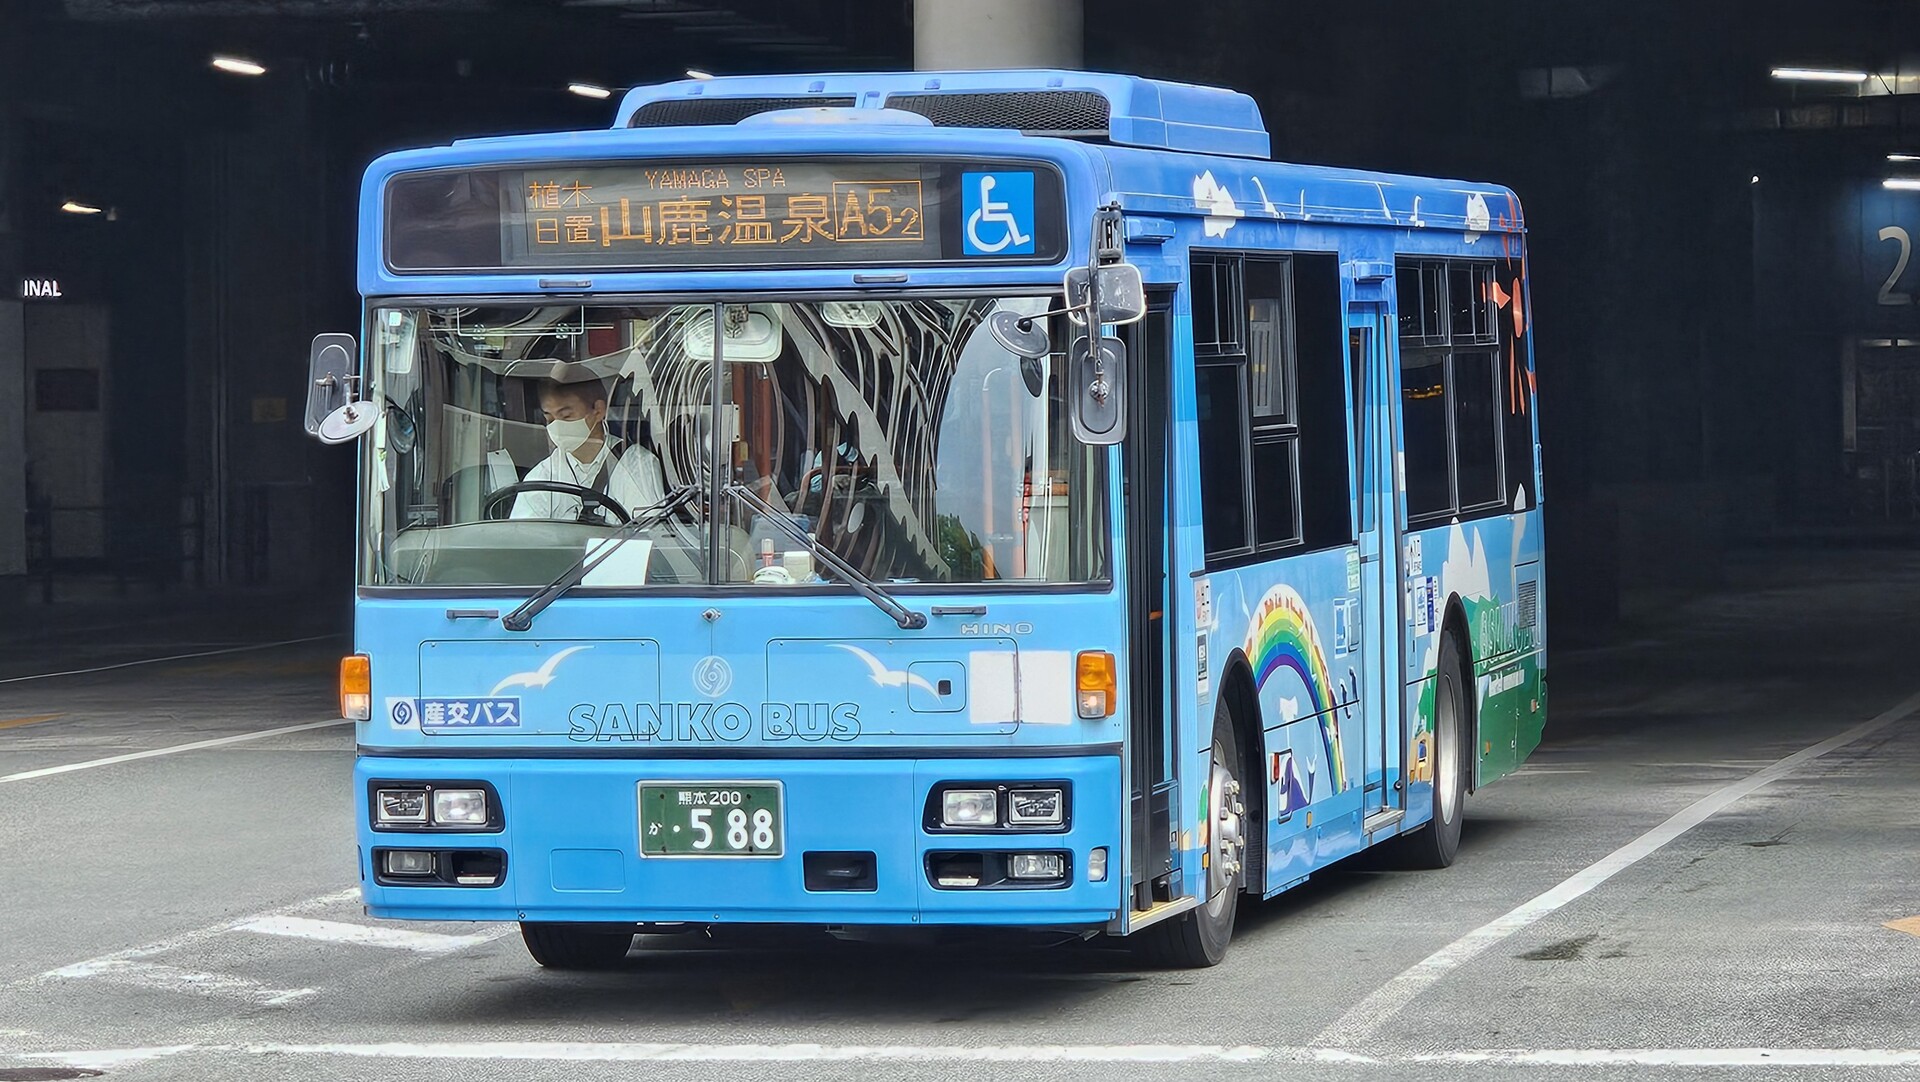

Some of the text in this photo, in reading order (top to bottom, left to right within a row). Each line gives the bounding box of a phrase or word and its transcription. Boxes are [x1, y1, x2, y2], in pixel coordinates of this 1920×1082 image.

[645, 168, 786, 190] YAMAGA SPA
[529, 180, 595, 209] 植木
[536, 215, 596, 244] 日置
[600, 194, 835, 247] 山鹿温泉
[1878, 226, 1911, 305] 2
[961, 622, 1034, 635] HINO
[424, 701, 519, 725] 産交バス
[568, 702, 862, 742] SANKO BUS
